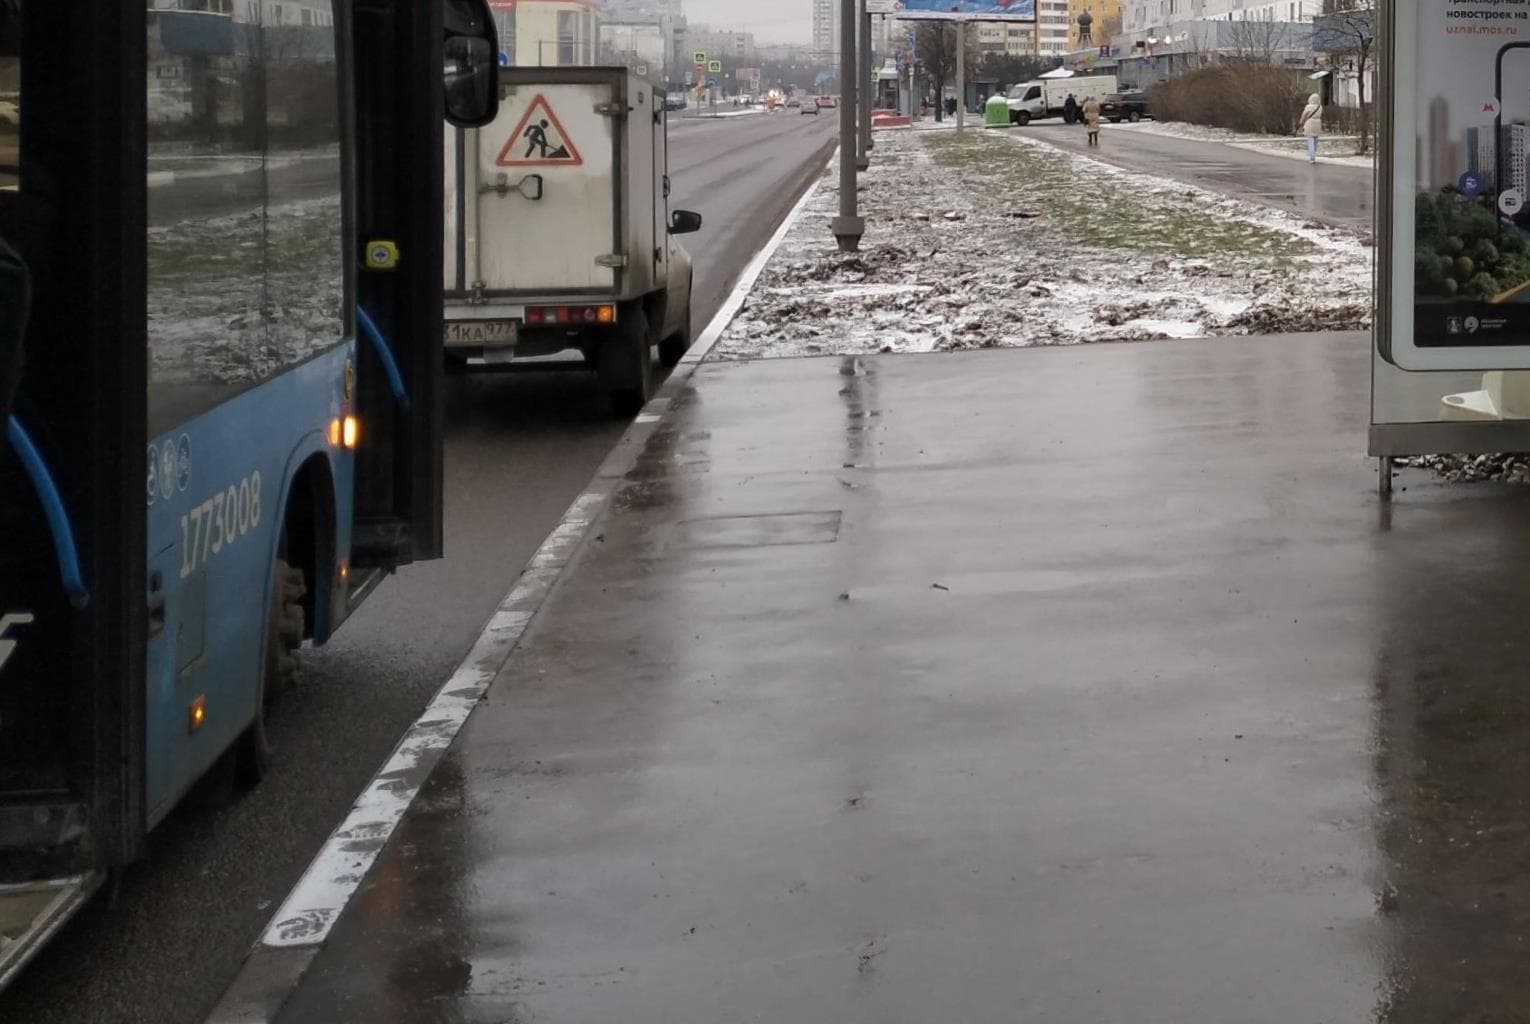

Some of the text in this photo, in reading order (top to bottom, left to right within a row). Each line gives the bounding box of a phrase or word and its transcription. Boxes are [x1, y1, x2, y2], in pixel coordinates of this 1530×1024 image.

[1446, 9, 1512, 21] новостроек
[1514, 11, 1528, 21] на
[179, 469, 262, 579] 1773008
